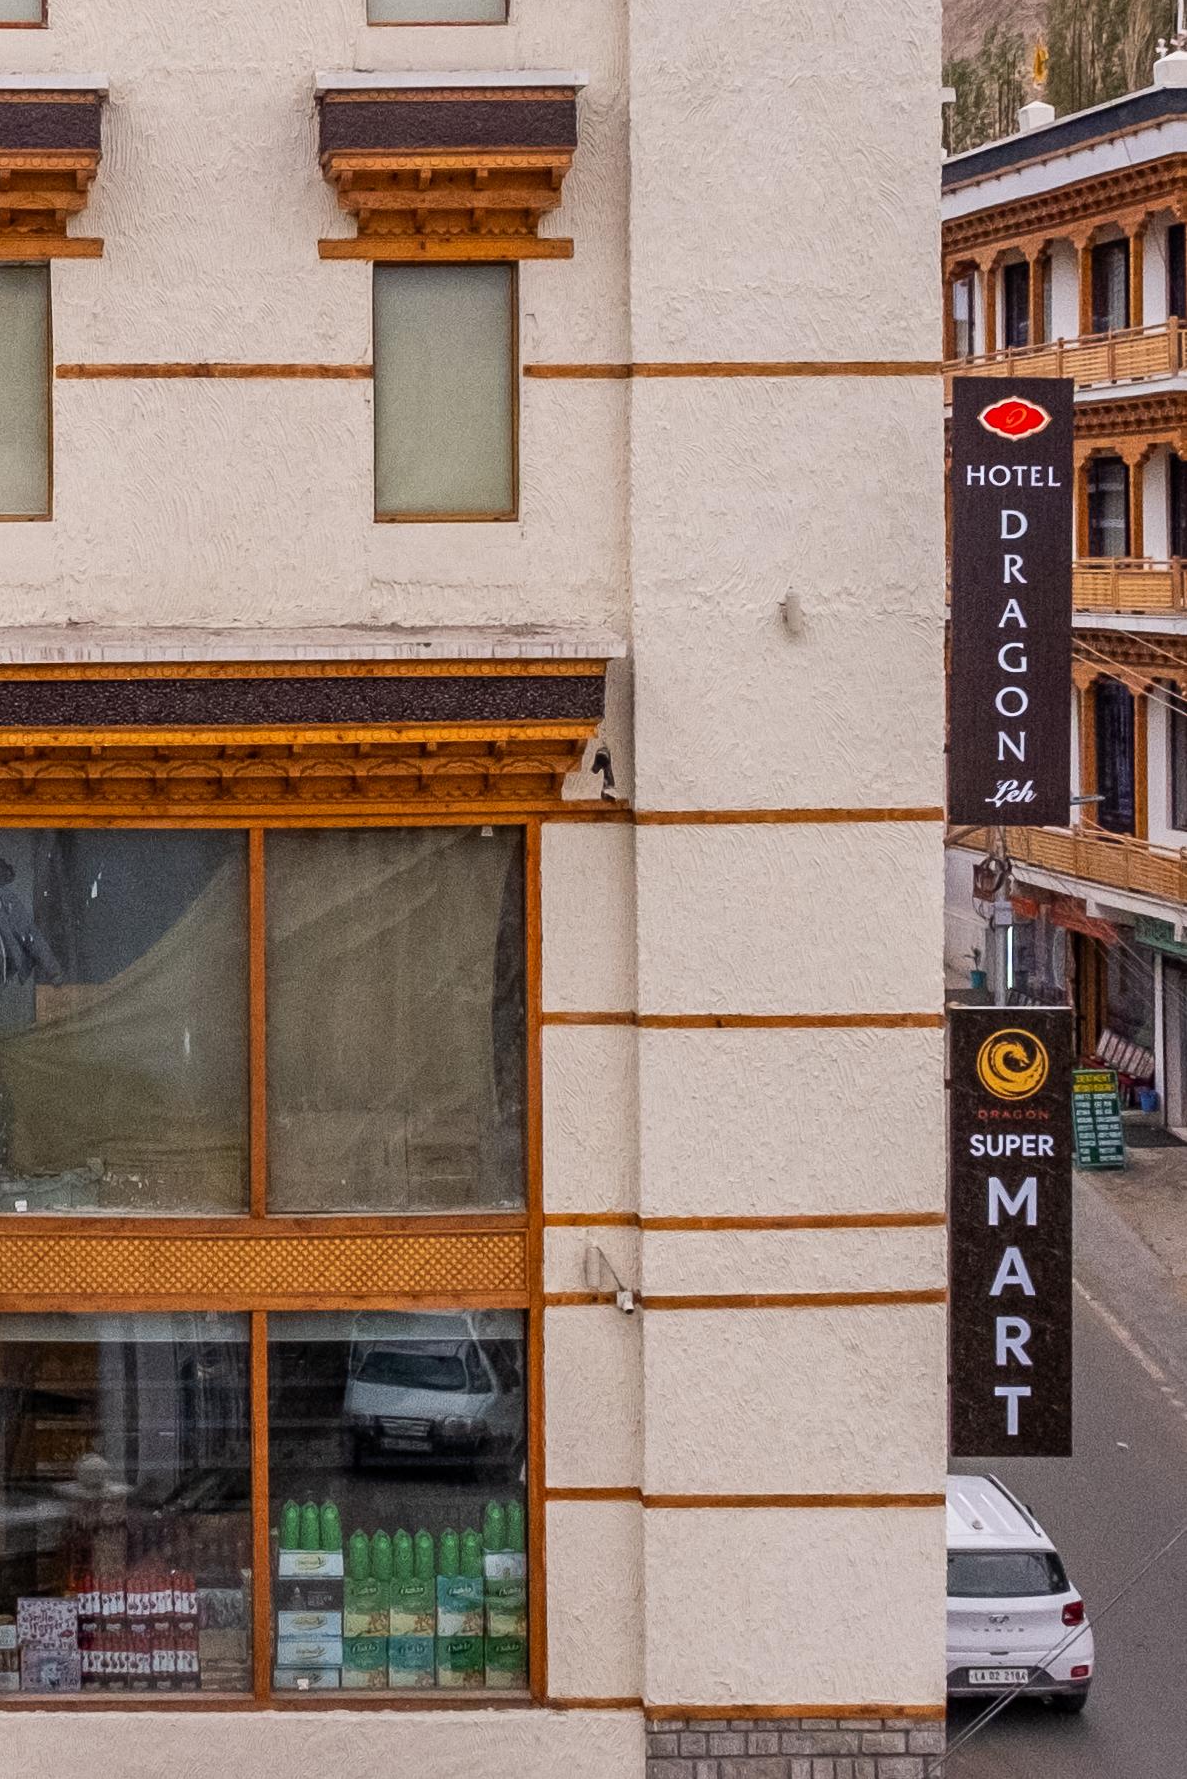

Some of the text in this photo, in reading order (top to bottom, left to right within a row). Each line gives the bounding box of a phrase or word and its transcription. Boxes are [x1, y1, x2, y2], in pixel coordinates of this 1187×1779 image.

[966, 465, 1062, 487] HOTEL
[995, 509, 1029, 762] DRAGON
[985, 780, 1037, 807] Leh
[977, 1108, 1049, 1120] DRAGON
[969, 1134, 1054, 1157] SUPER
[988, 1176, 1038, 1436] MART
